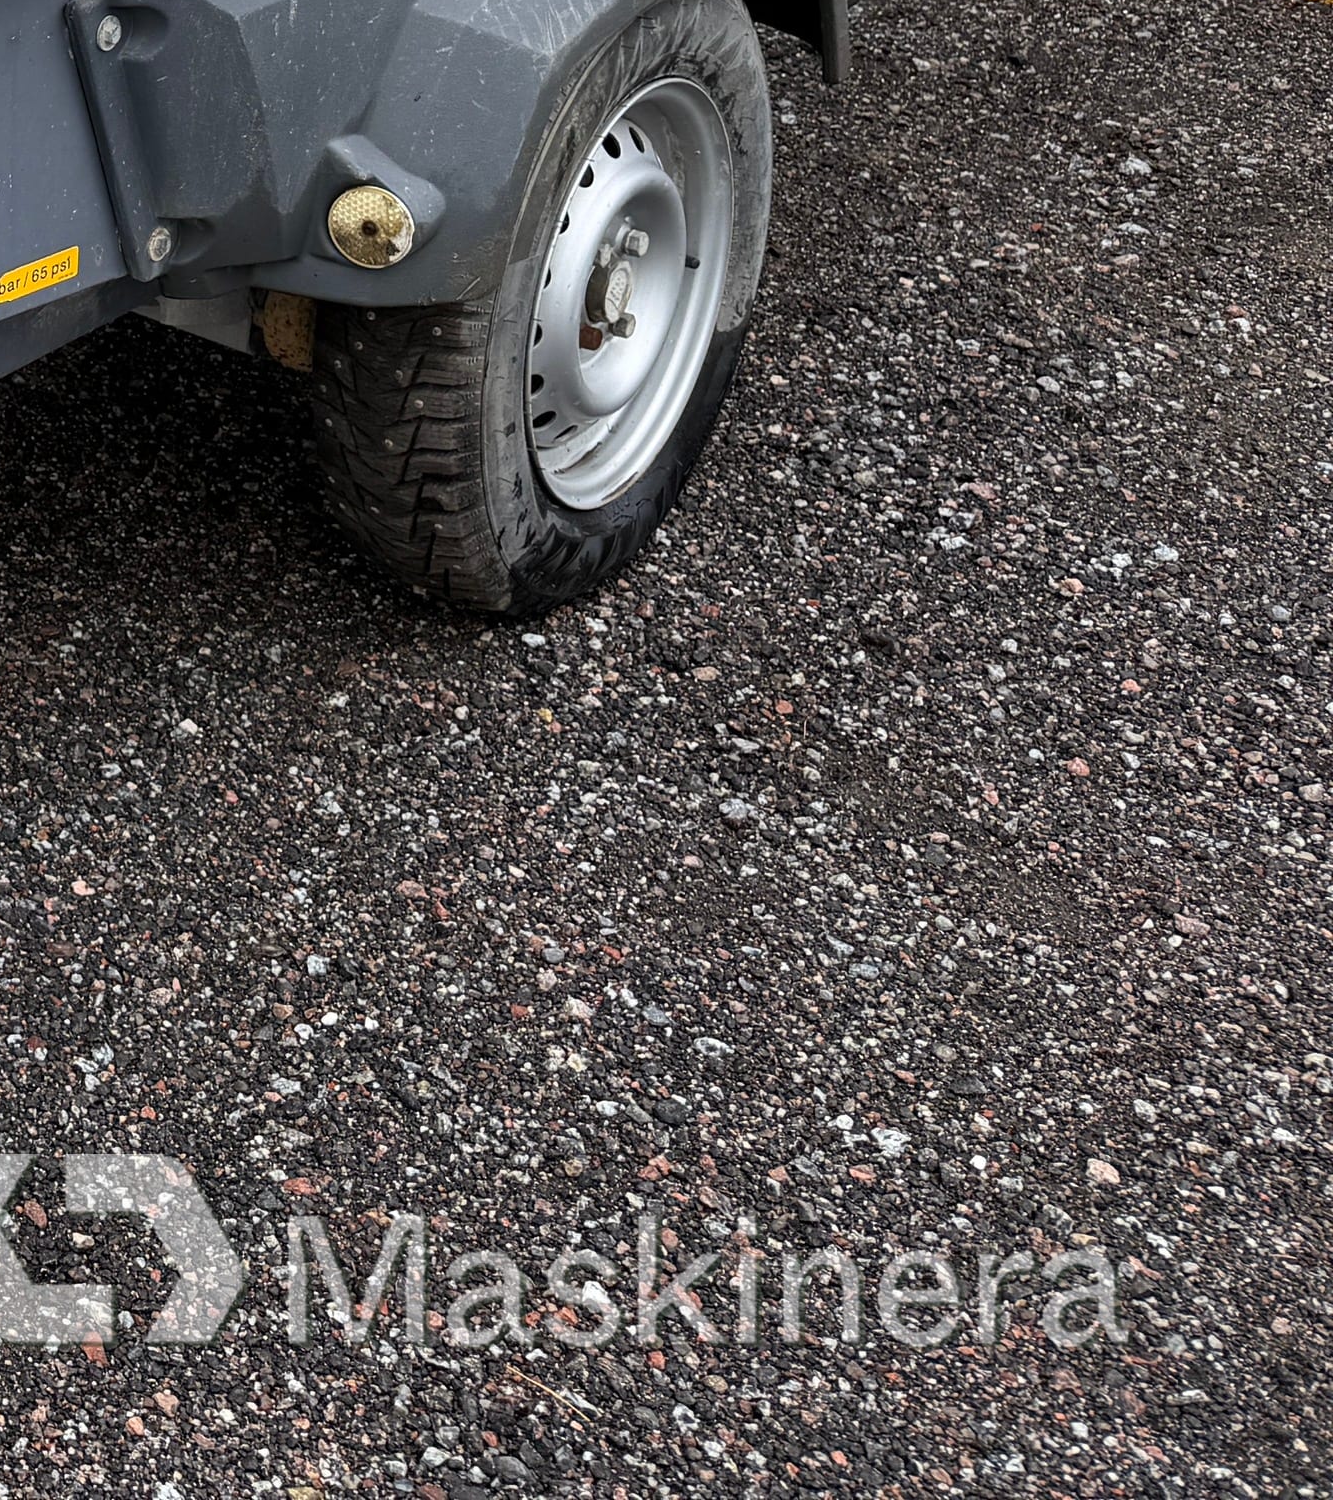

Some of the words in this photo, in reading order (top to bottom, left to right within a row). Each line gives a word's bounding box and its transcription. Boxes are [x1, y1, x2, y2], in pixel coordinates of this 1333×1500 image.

[23, 271, 30, 288] /
[31, 265, 48, 283] 65
[51, 255, 71, 279] psi
